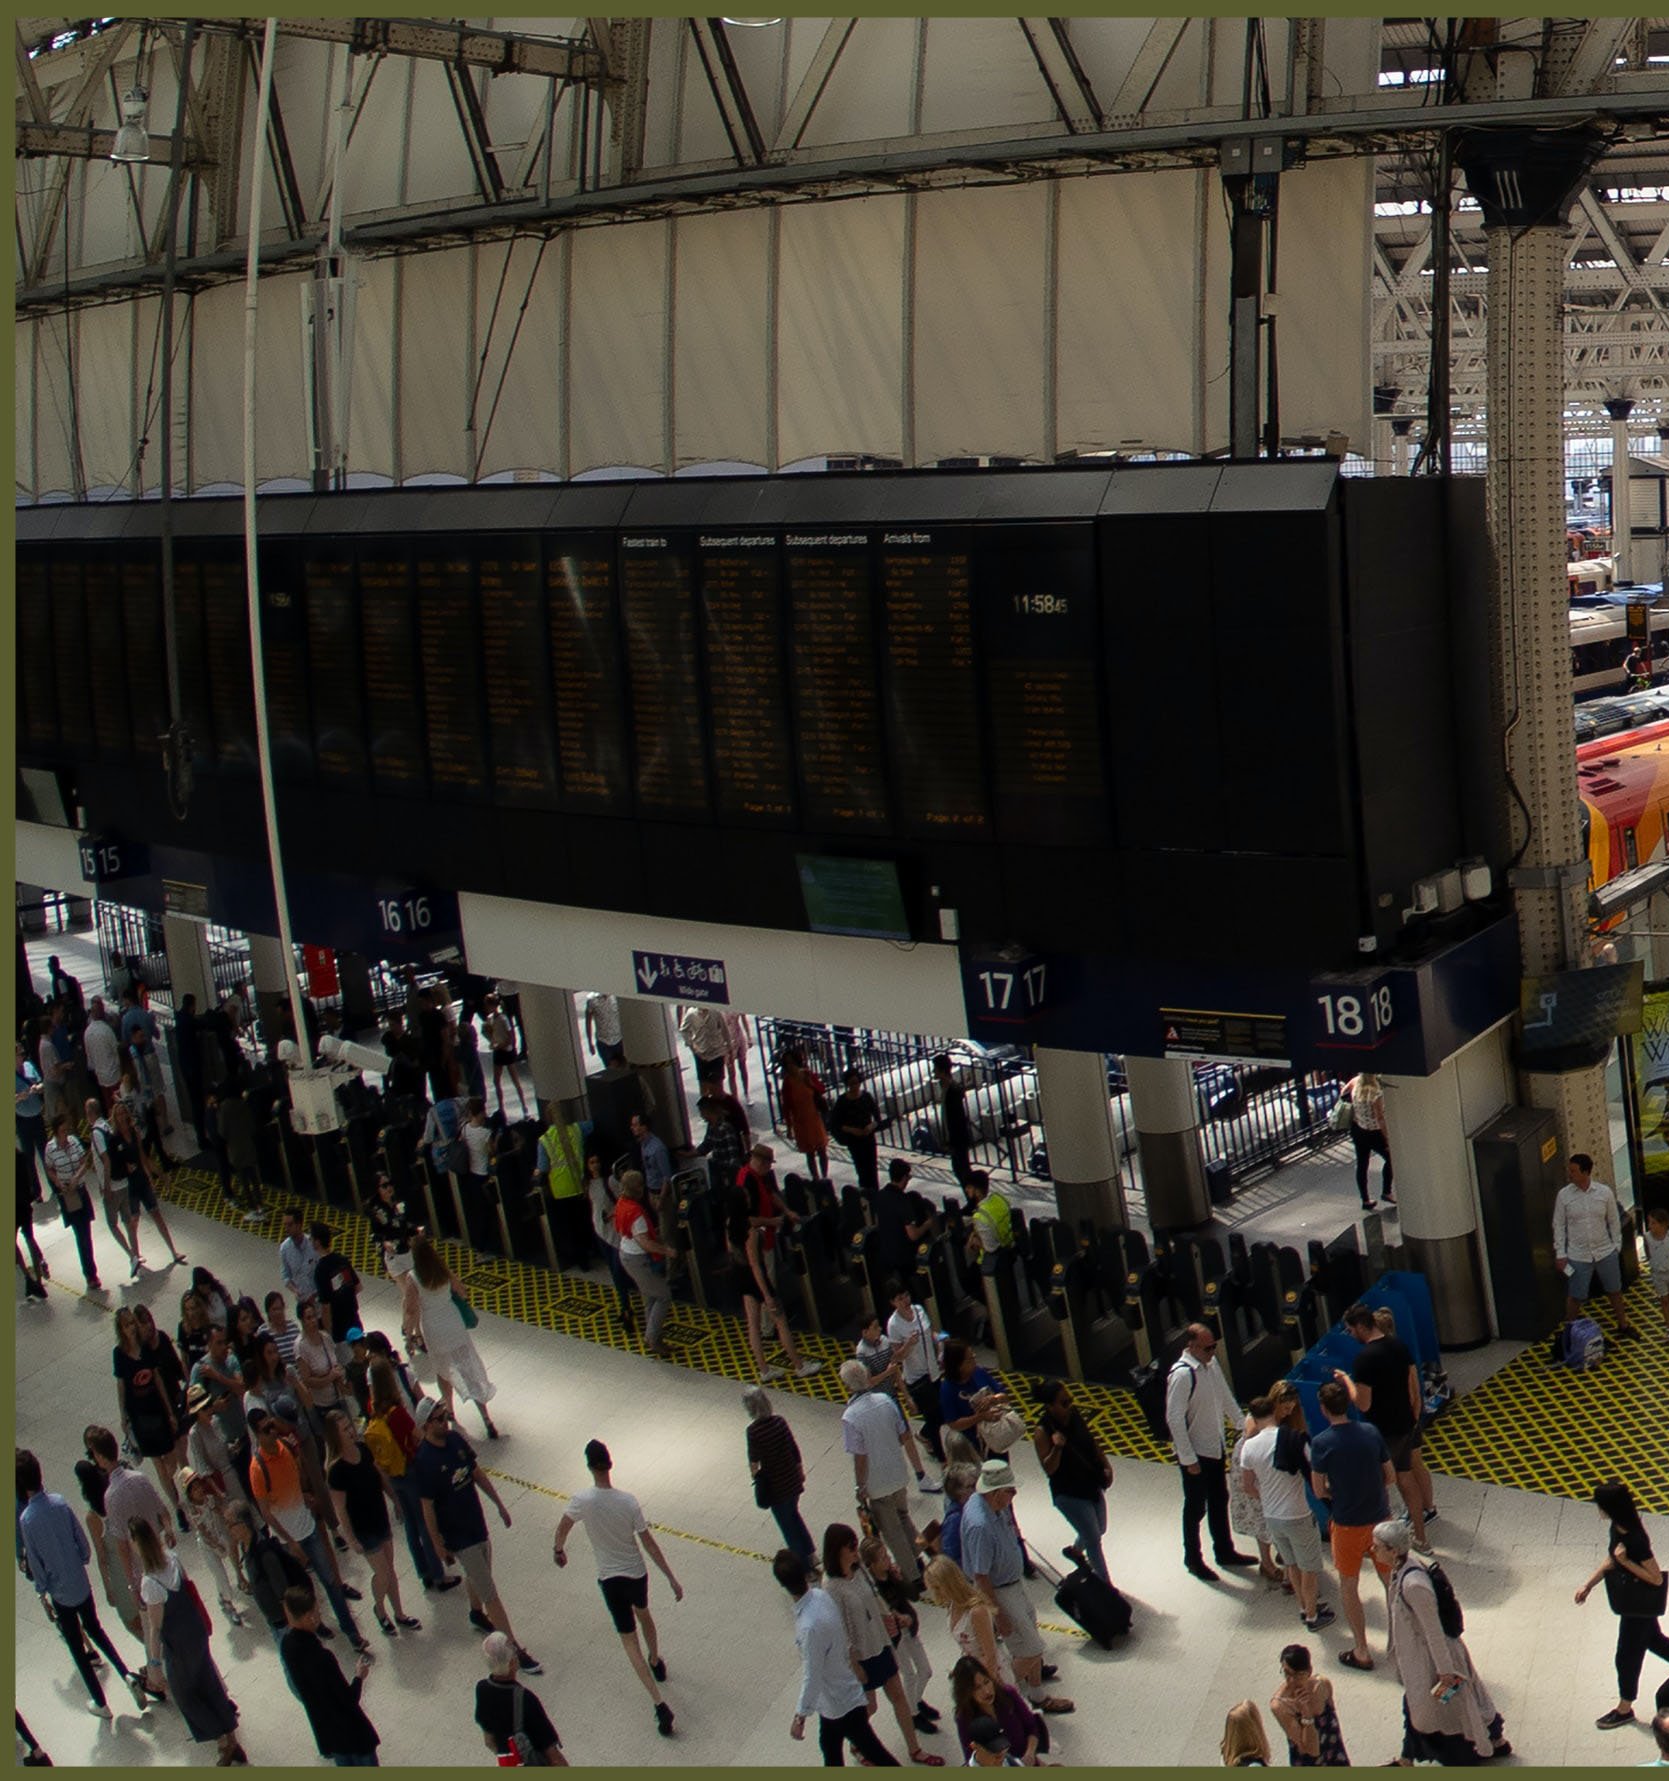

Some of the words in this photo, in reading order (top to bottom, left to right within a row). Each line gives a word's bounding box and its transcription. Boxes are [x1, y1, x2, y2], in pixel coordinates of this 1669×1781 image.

[784, 534, 821, 546] Subsequent
[822, 534, 868, 546] departures
[912, 533, 932, 544] from
[81, 847, 95, 875] 15
[99, 845, 121, 874] 15
[378, 899, 401, 932] 16
[404, 896, 431, 931] 16
[978, 970, 1014, 1010] 17
[1022, 963, 1047, 1007] 17
[1317, 994, 1364, 1036] 18
[1369, 985, 1394, 1032] 18
